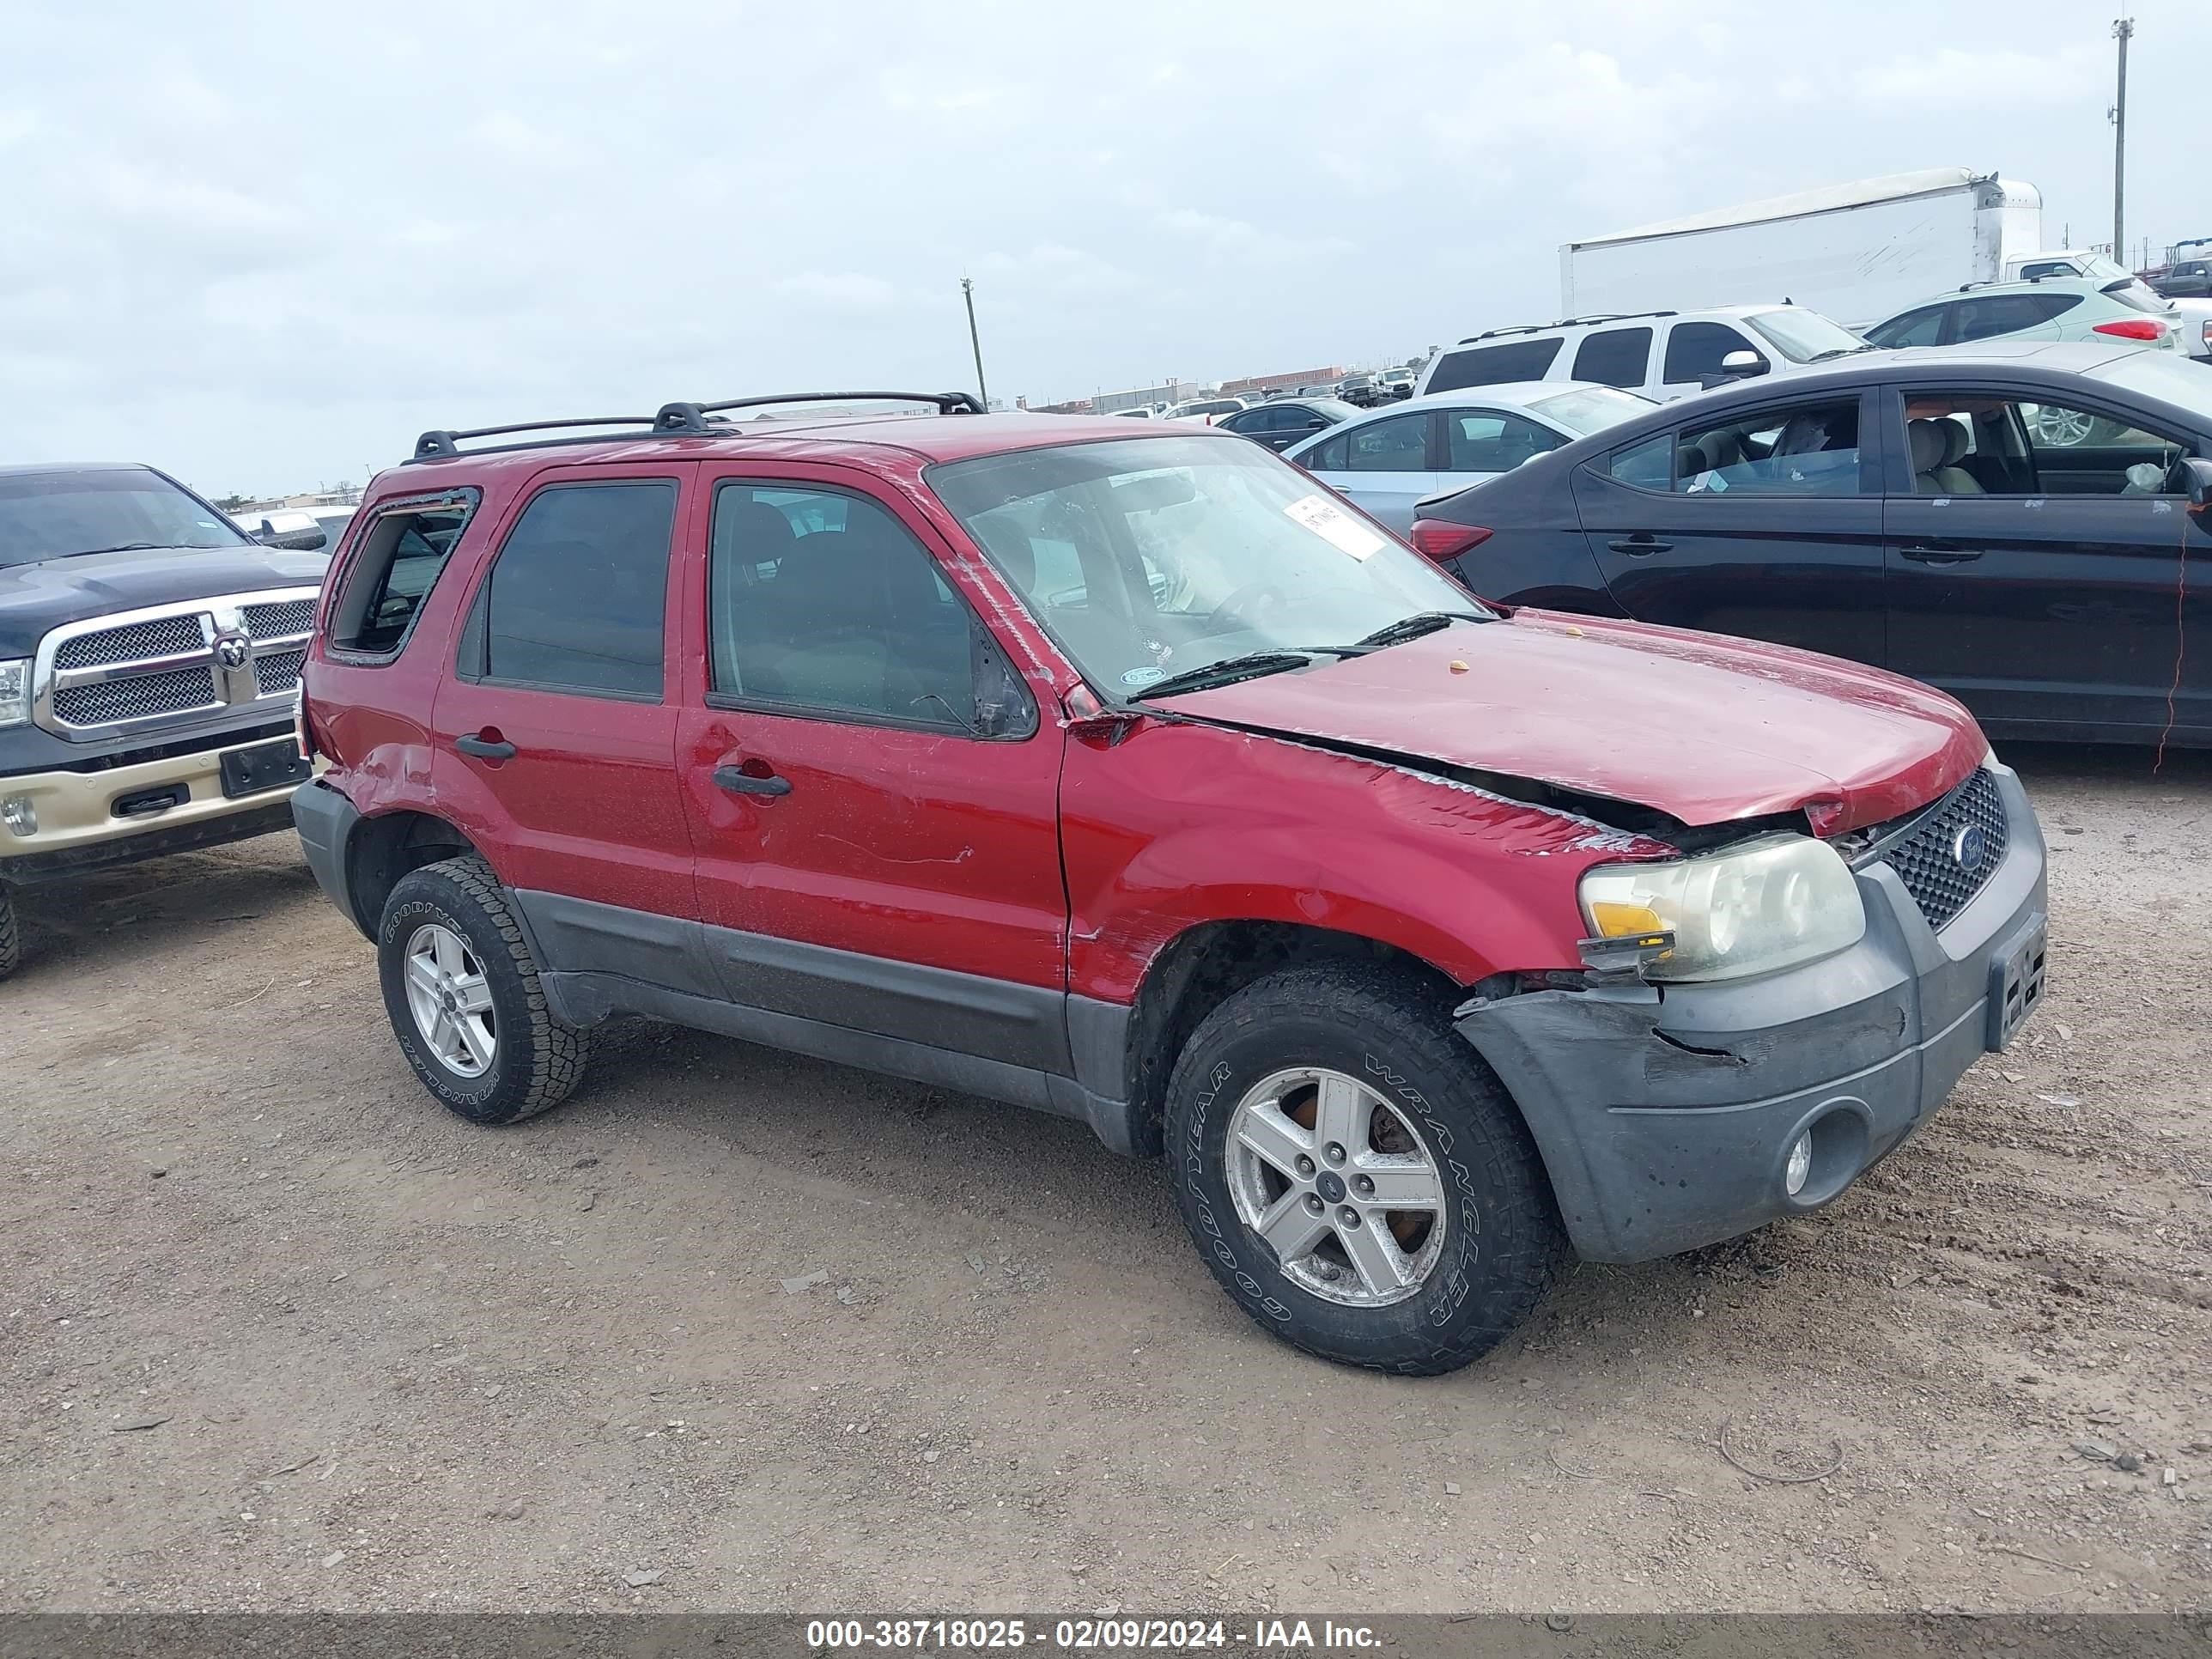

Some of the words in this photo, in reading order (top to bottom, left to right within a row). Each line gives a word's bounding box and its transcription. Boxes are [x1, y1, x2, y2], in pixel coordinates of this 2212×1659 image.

[1964, 834, 1982, 860] Ford
[401, 1035, 501, 1105] WRANGLER
[1187, 1060, 1291, 1322] GOODYEAR
[1365, 1053, 1480, 1328] WRANGLER
